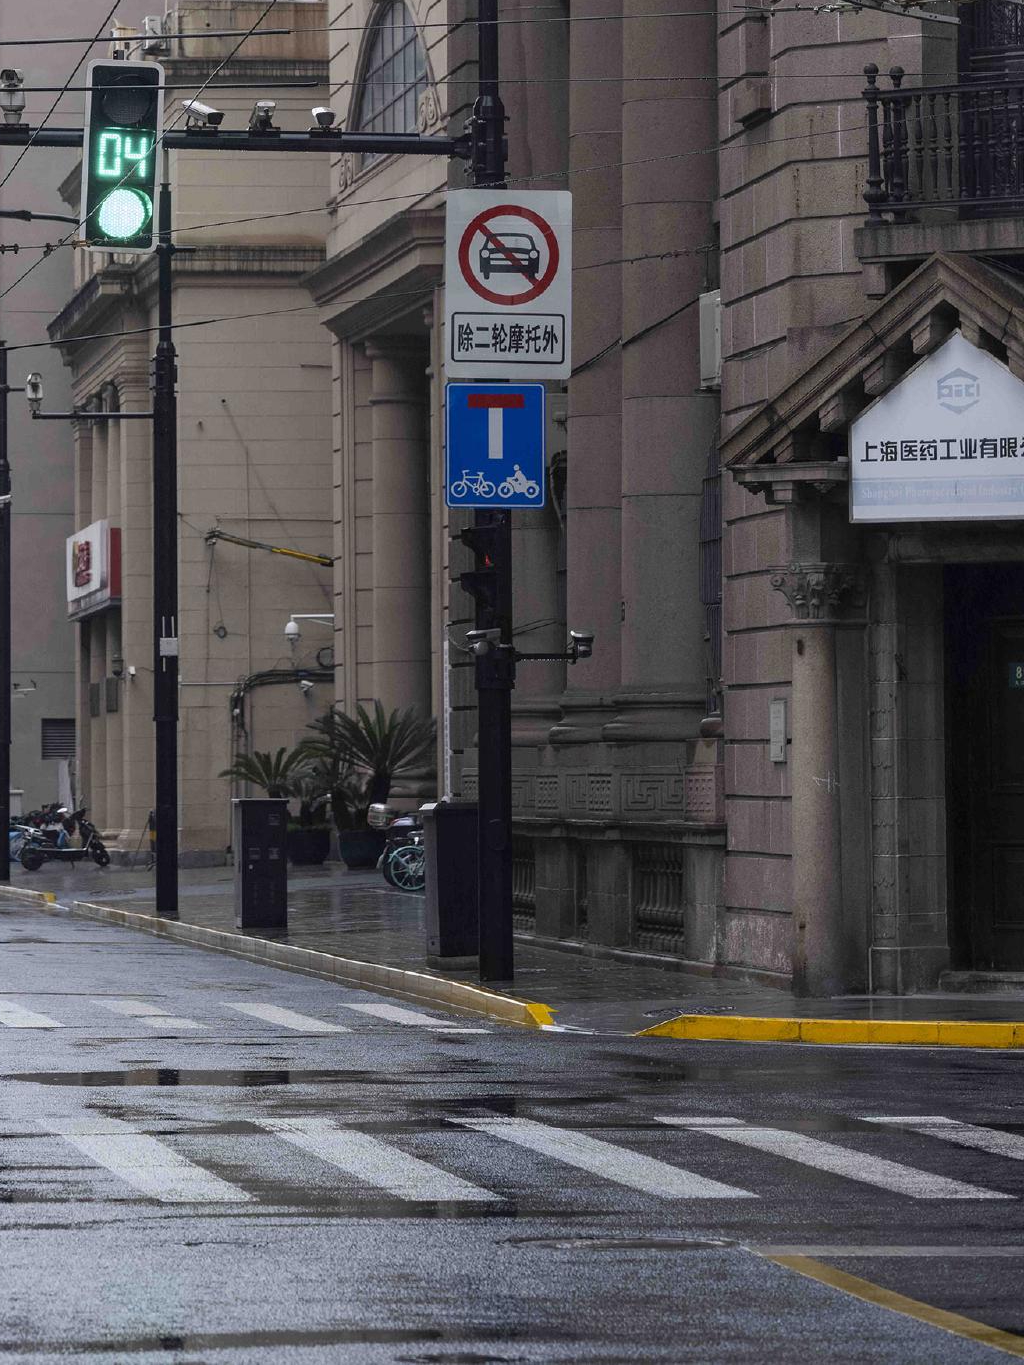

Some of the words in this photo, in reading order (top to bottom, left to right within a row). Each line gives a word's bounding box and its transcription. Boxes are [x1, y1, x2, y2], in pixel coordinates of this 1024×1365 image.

[98, 133, 147, 177] 04
[457, 323, 558, 355] 除二轮摩托外
